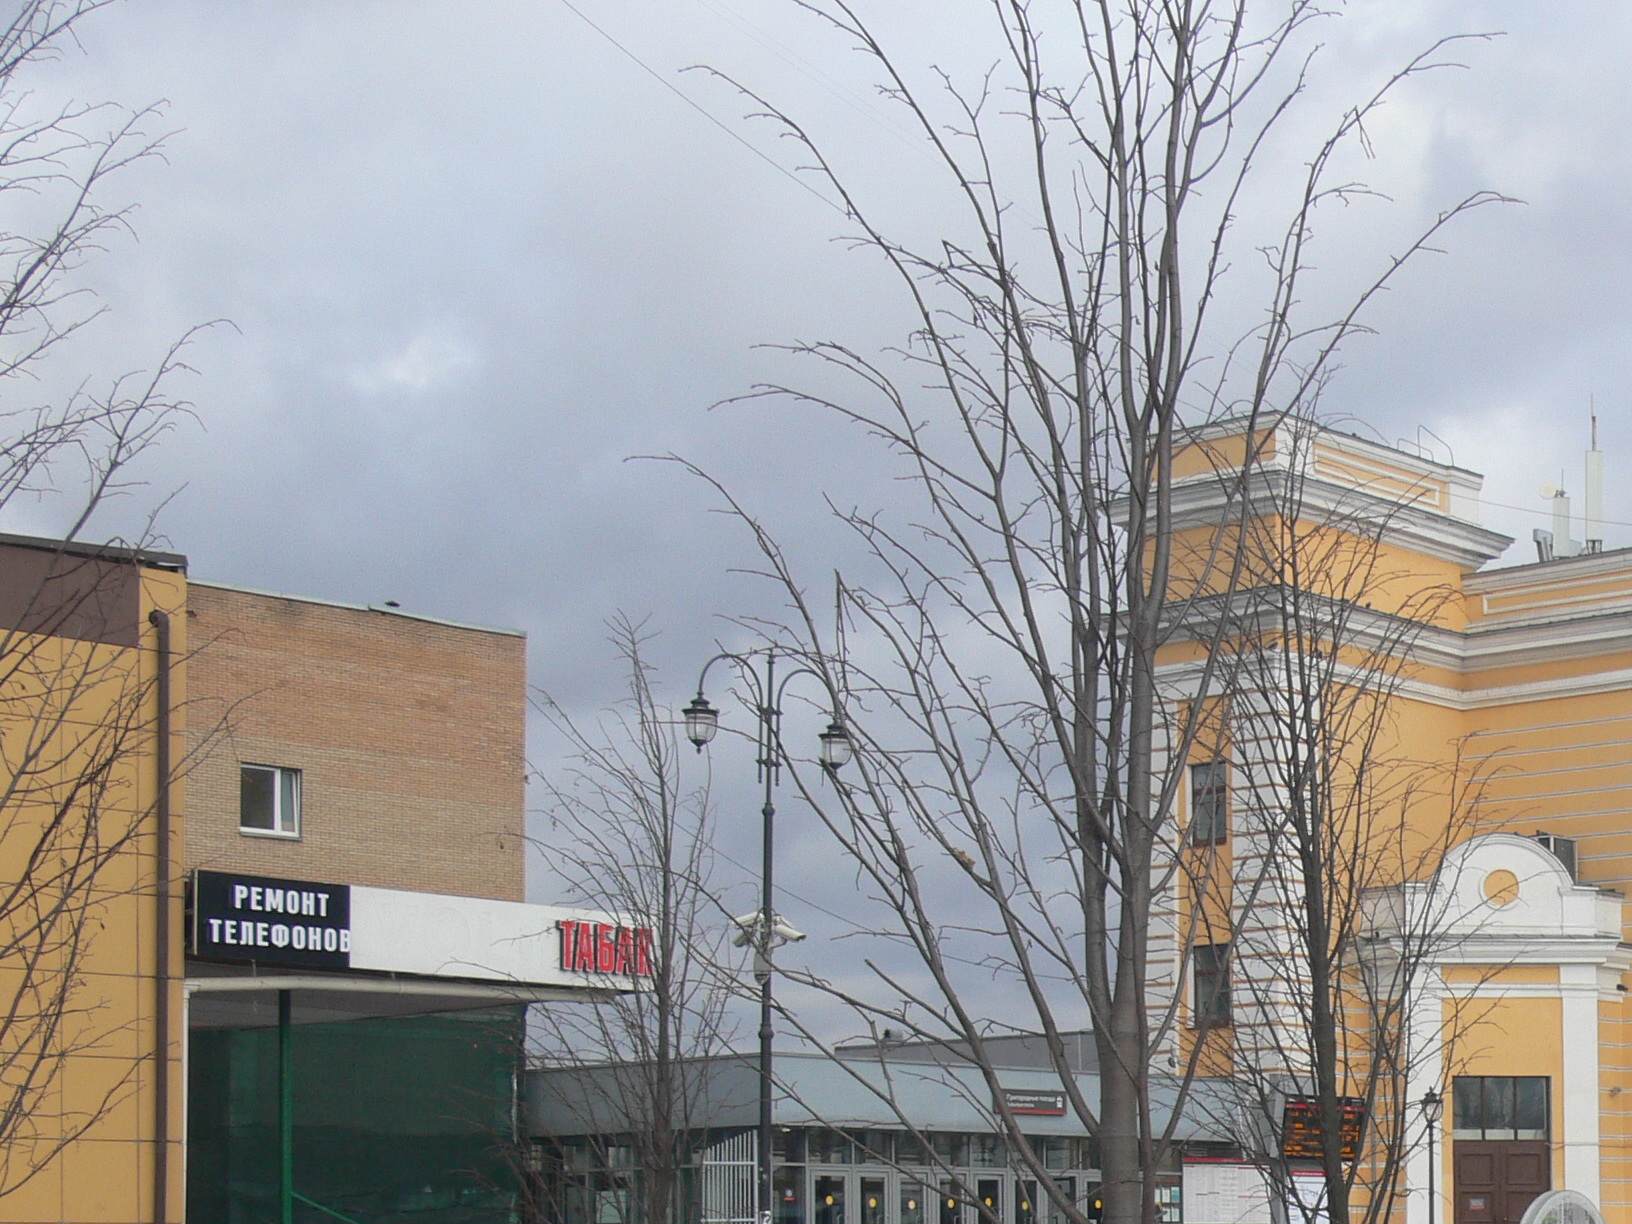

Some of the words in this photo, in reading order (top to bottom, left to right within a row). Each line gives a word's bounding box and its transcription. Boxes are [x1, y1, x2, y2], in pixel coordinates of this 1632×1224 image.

[233, 884, 330, 917] РЕМОНТ
[209, 918, 351, 953] ТЕЛЕФОНОВ
[556, 920, 654, 977] ТАБАК
